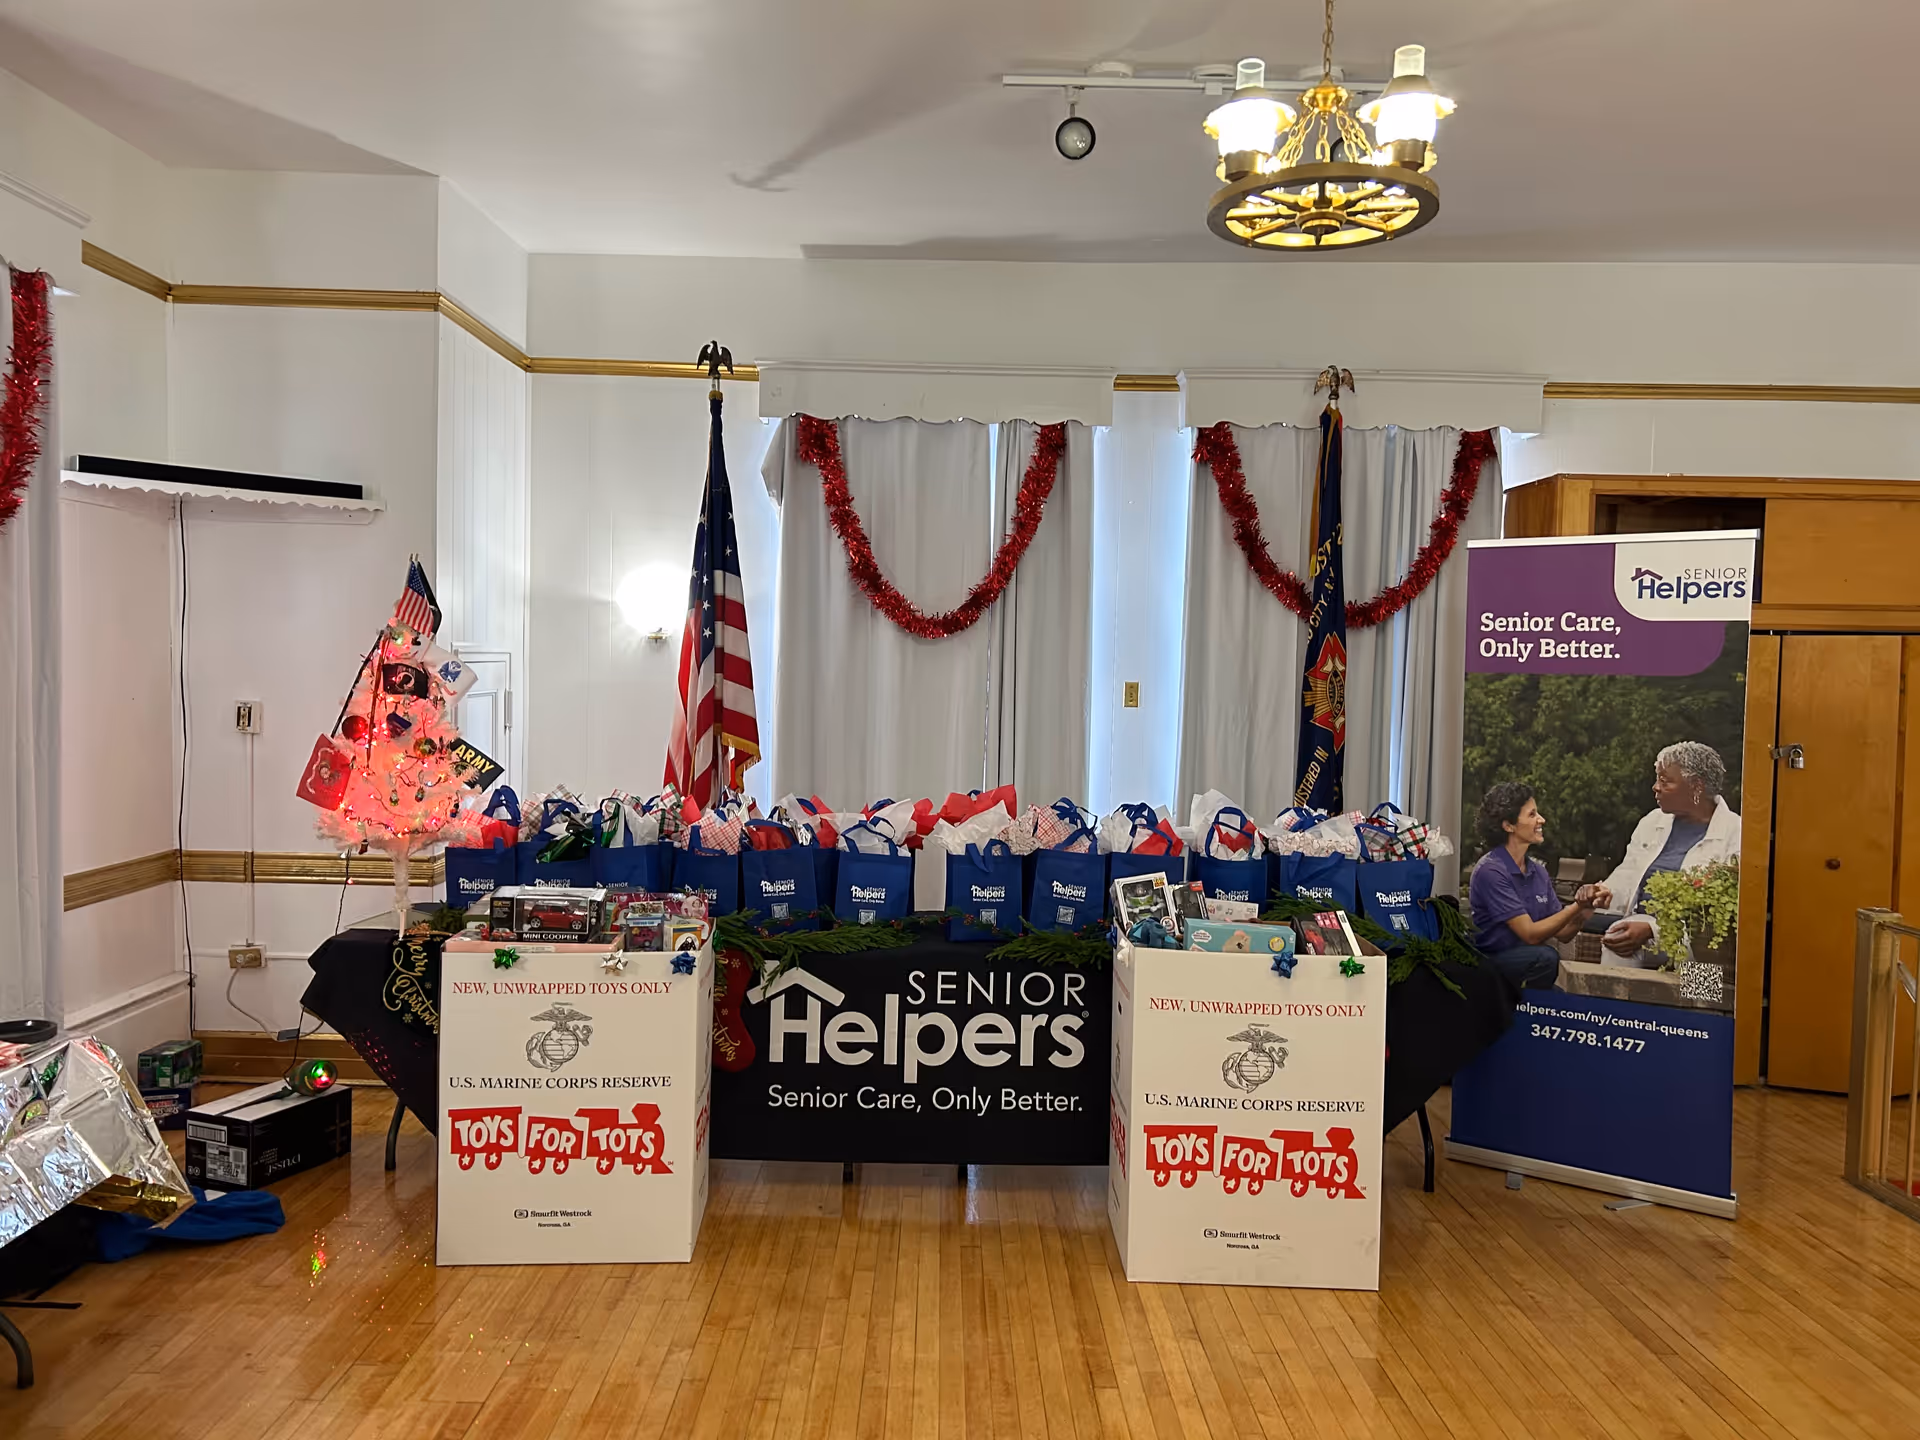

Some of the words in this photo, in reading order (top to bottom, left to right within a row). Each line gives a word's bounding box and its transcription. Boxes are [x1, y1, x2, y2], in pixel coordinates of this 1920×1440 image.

[1684, 568, 1747, 580] SENIOR
[1638, 576, 1746, 604] Helpers
[1480, 612, 1554, 632] Senior
[1560, 612, 1621, 635] Care,
[1479, 638, 1533, 662] Only
[1539, 638, 1621, 659] Better.
[455, 744, 494, 773] ARMY
[1314, 745, 1329, 763] IN
[460, 880, 495, 892] Helpers
[762, 882, 795, 893] Helpers
[852, 889, 886, 900] Helpers
[973, 888, 1005, 899] Helpers
[1053, 884, 1086, 898] Helpers
[1379, 893, 1411, 904] Helpers
[452, 982, 489, 996] NEW,
[493, 982, 586, 995] UNWRAPPED
[592, 982, 628, 994] TOYS
[631, 981, 673, 994] ONLY
[906, 970, 1086, 1006] SENIOR
[1150, 997, 1186, 1013] NEW,
[1190, 1000, 1282, 1016] UNWRAPPED
[1285, 1004, 1323, 1017] TOYS
[1326, 1005, 1366, 1017] ONLY
[1531, 1023, 1646, 1053] 347.798.1477
[449, 1077, 476, 1089] U.S.
[479, 1077, 542, 1089] MARINE
[545, 1077, 598, 1089] CORPS
[601, 1076, 671, 1088] RESERVE
[768, 1084, 848, 1108] Senior
[857, 1086, 922, 1114] Care,
[932, 1087, 991, 1117] Only
[1000, 1088, 1083, 1112] Better.
[1145, 1093, 1172, 1106] U.S.
[1175, 1095, 1238, 1110] MARINE
[1241, 1098, 1293, 1112] CORPS
[1296, 1100, 1366, 1113] RESERVE
[455, 1114, 514, 1148] TOYS
[528, 1123, 576, 1155] FOR
[592, 1127, 655, 1159] TOTS
[1150, 1133, 1210, 1166] TOYS
[1223, 1143, 1271, 1176] FOR
[1286, 1150, 1349, 1183] TOTS
[530, 1210, 559, 1218] Smurfit
[1220, 1230, 1248, 1239] Smurfit
[1248, 1231, 1281, 1241] Westrock
